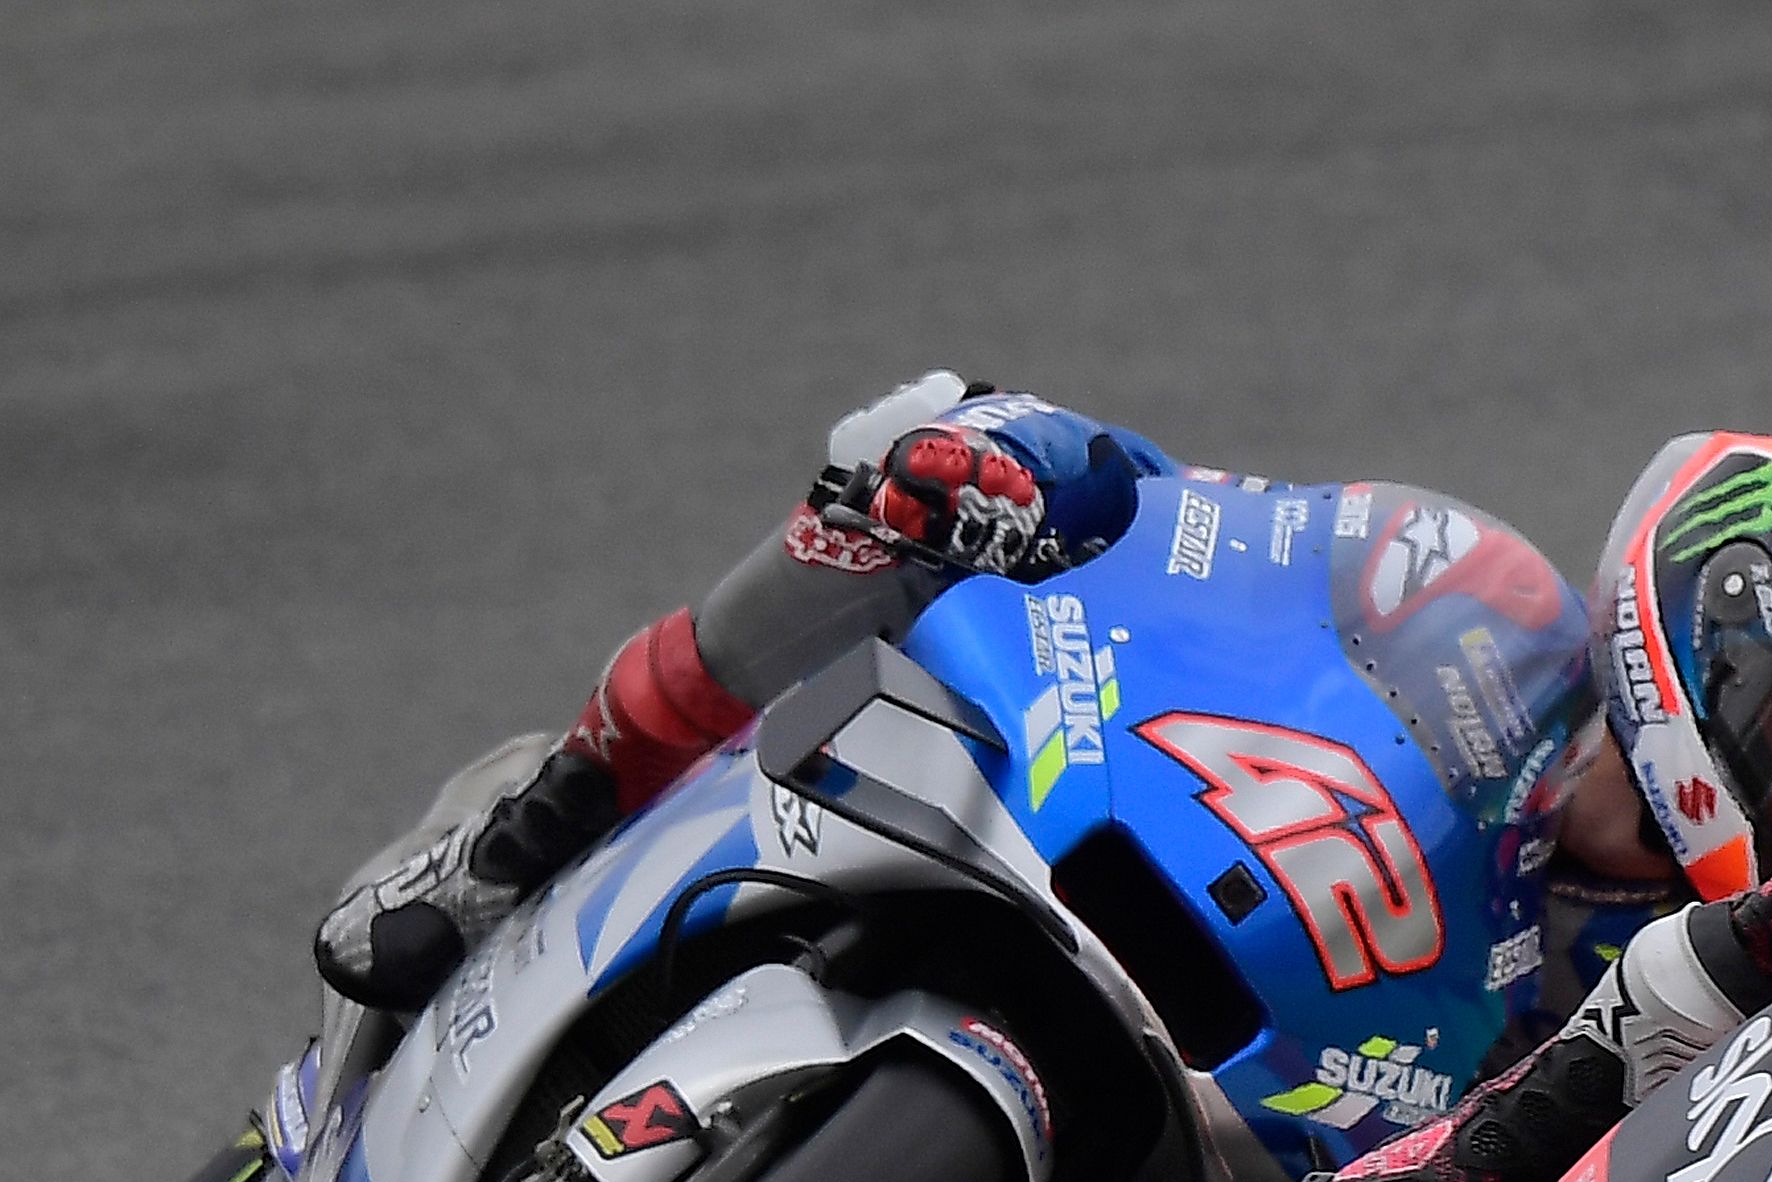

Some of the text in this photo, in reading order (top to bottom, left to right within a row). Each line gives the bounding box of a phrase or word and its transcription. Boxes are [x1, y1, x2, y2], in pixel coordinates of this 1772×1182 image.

[1046, 594, 1105, 766] SUZUKI
[1127, 707, 1447, 994] 42
[1316, 1047, 1452, 1112] SUZUKI
